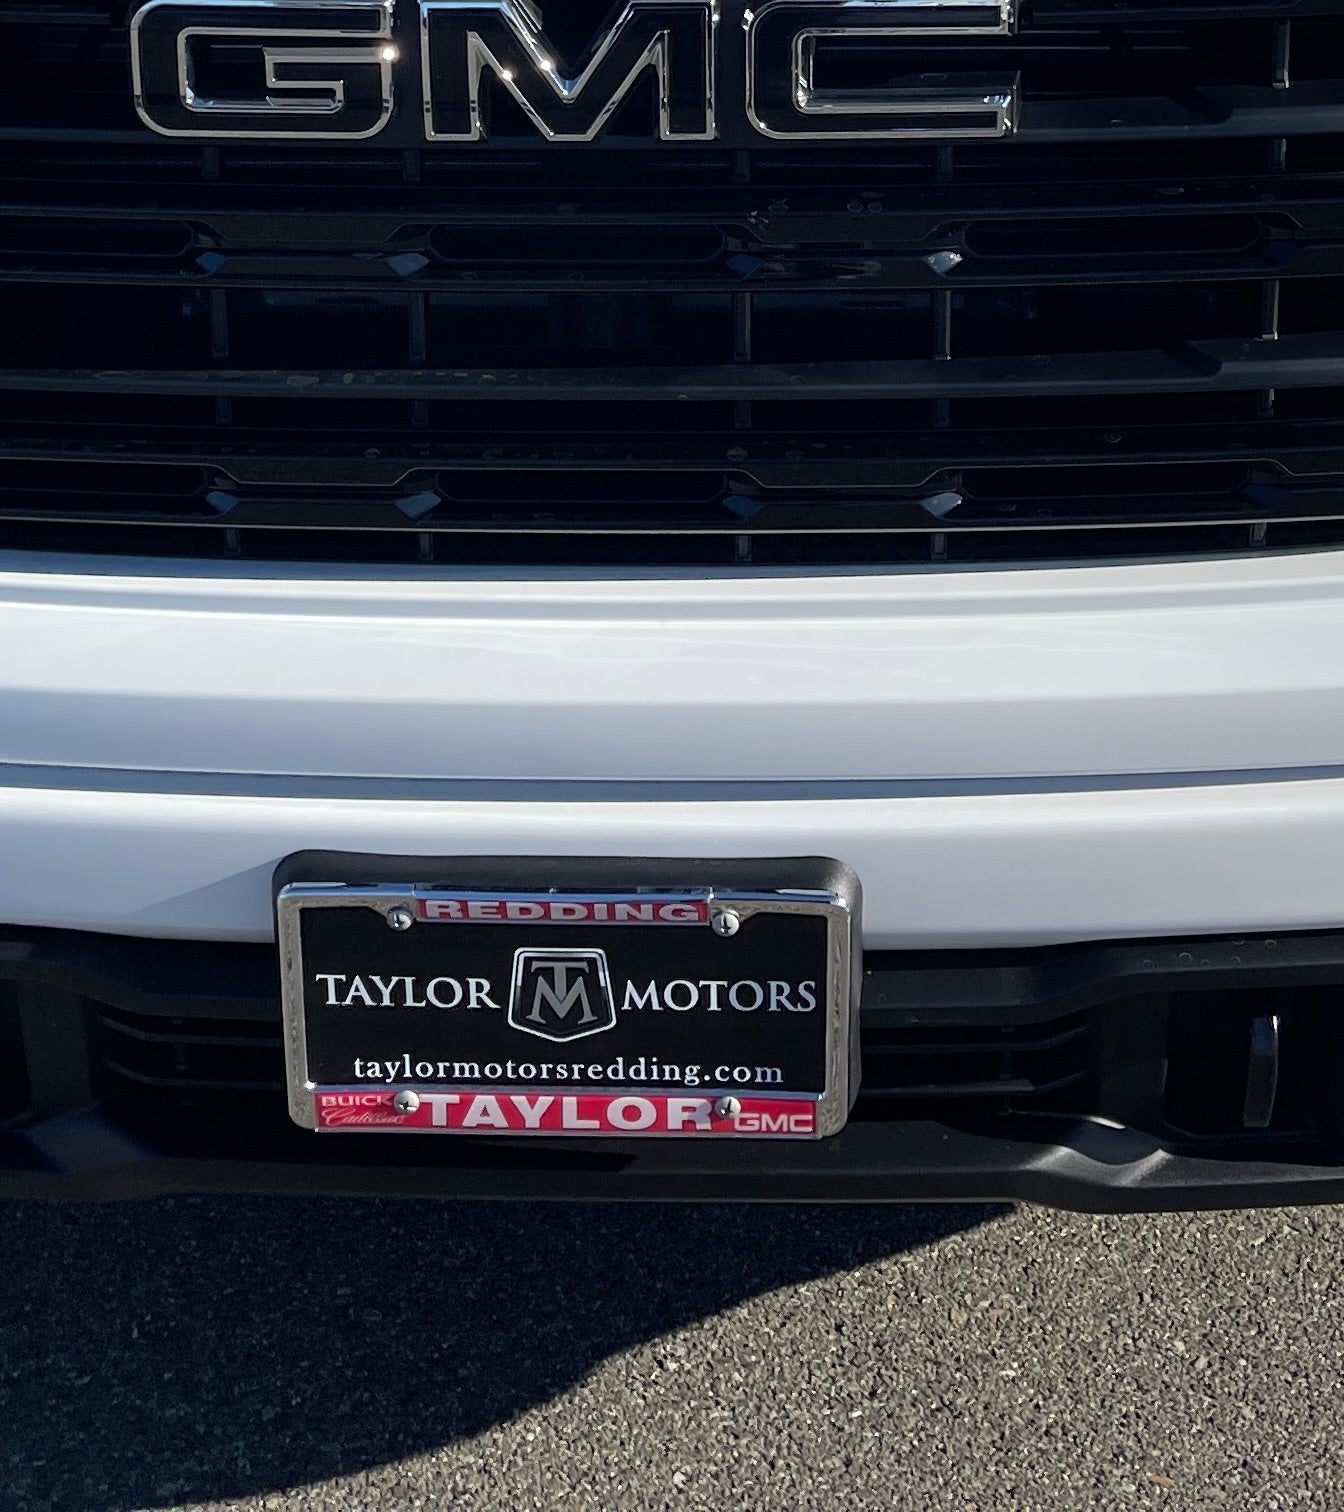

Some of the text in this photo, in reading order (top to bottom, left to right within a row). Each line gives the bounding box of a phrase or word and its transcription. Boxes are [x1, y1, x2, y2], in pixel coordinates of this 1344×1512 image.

[425, 899, 699, 922] REDDING
[316, 974, 817, 1012] TAYLOR MOTORS
[354, 1054, 784, 1086] taylormotorsredding.com
[321, 1095, 393, 1106] BUICK
[419, 1093, 713, 1130] TAYLOR
[734, 1112, 813, 1132] GMC
